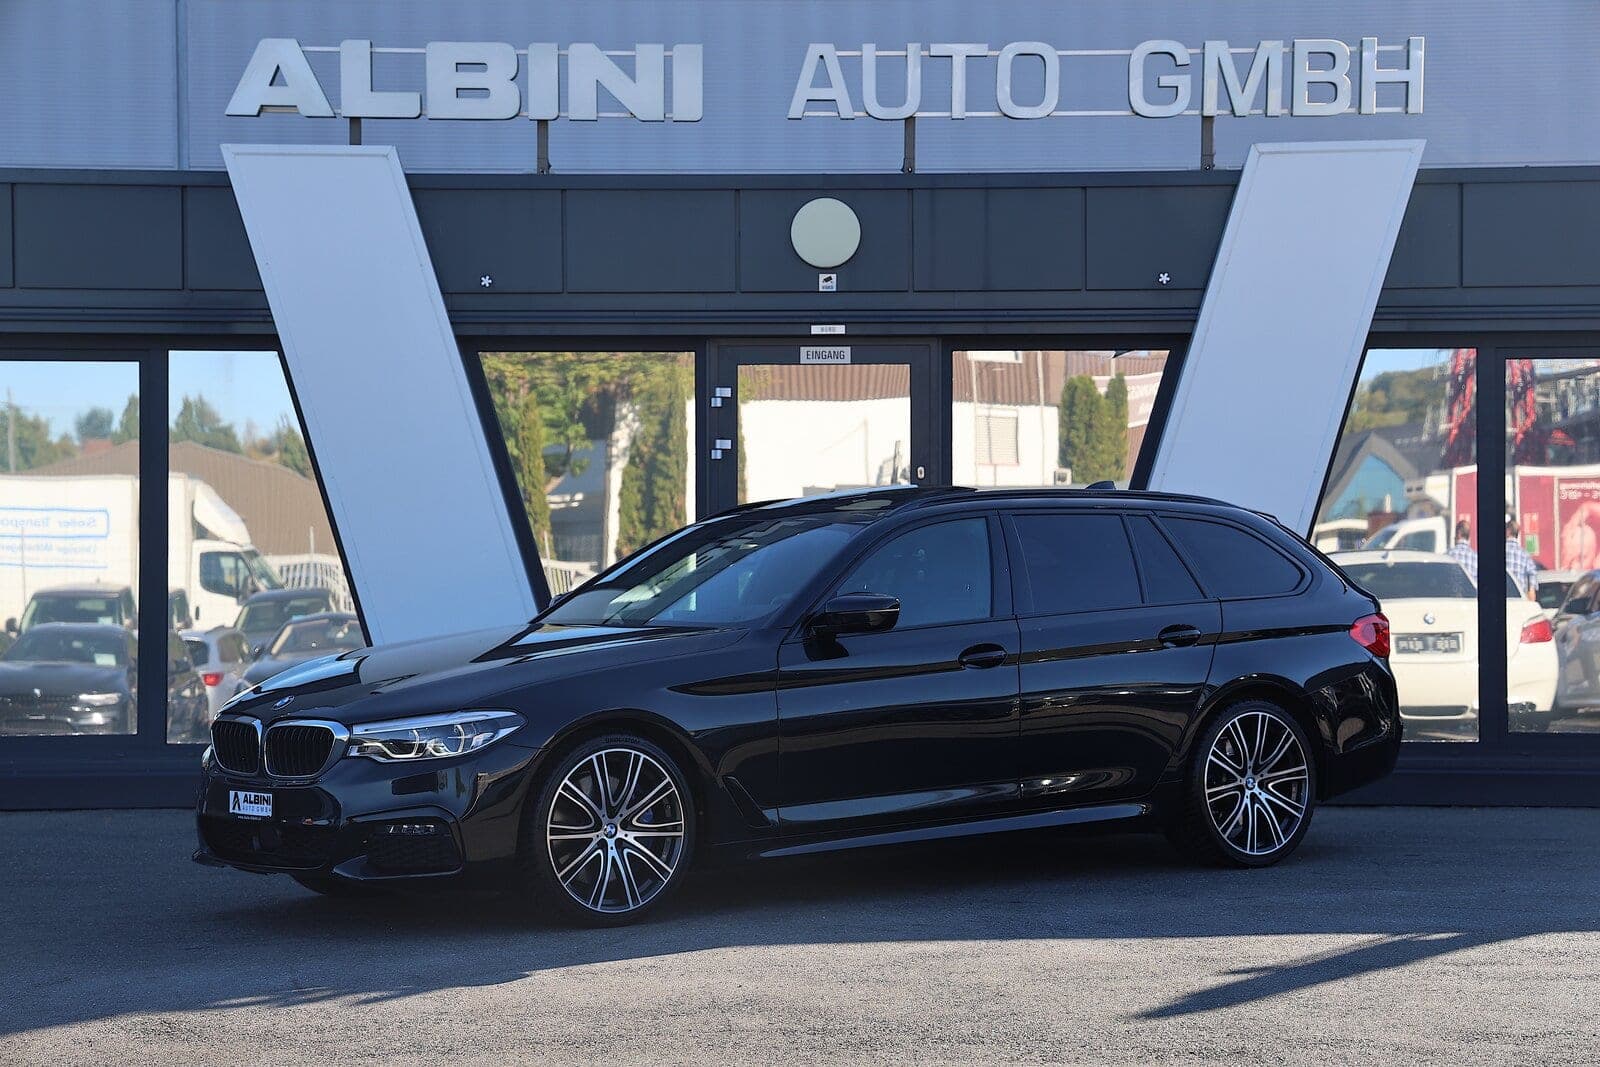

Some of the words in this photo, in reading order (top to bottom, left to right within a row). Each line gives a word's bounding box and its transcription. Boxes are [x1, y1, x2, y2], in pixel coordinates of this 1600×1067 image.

[225, 38, 704, 122] ALBINI
[787, 41, 1060, 121] AUTO
[1127, 36, 1426, 118] GMBH
[806, 350, 845, 360] EINGANG
[242, 793, 271, 805] ALBINI
